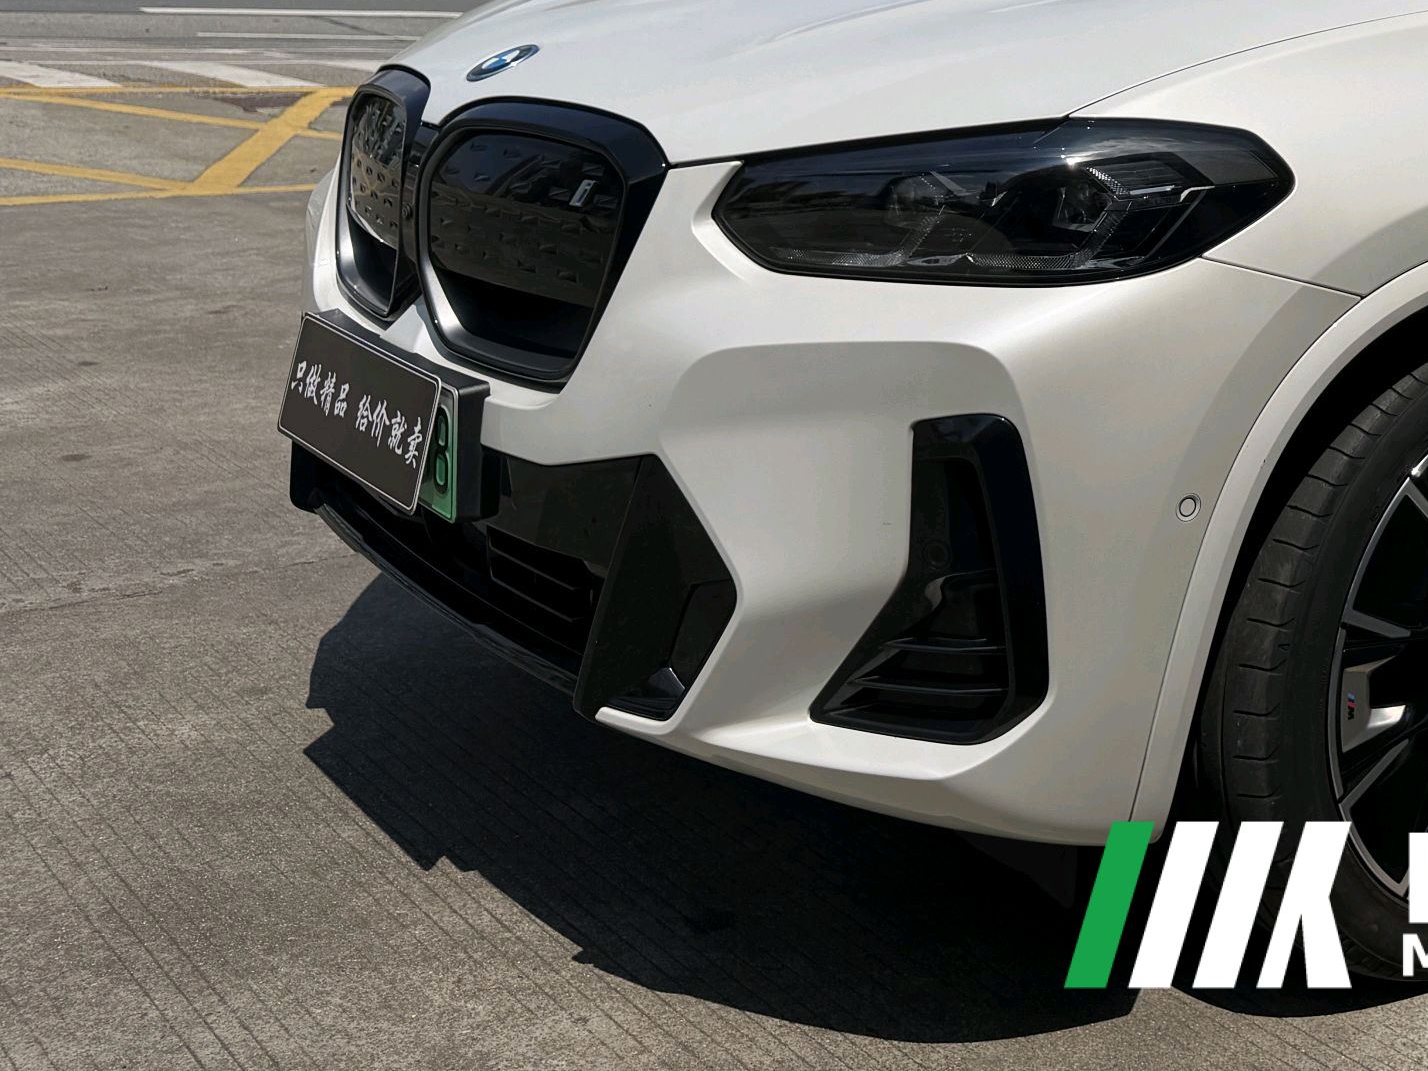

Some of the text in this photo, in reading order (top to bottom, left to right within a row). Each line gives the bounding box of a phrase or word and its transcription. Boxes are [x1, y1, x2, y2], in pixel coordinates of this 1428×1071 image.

[291, 360, 423, 469] 只做精品 给价就卖
